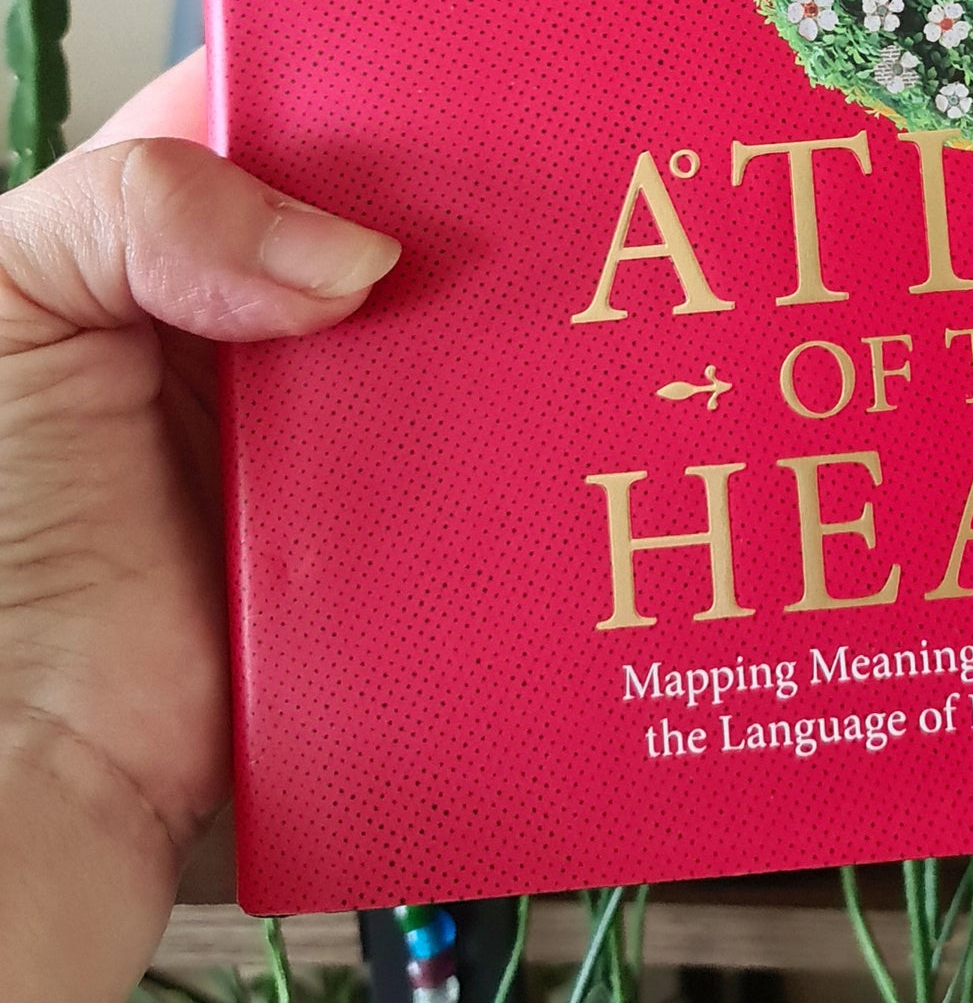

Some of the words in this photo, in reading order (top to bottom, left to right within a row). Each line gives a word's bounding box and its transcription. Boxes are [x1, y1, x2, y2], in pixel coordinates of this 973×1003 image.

[779, 334, 912, 419] OF
[622, 655, 799, 708] Mapping
[645, 719, 707, 759] the
[719, 708, 908, 756] Language
[919, 690, 961, 734] of
